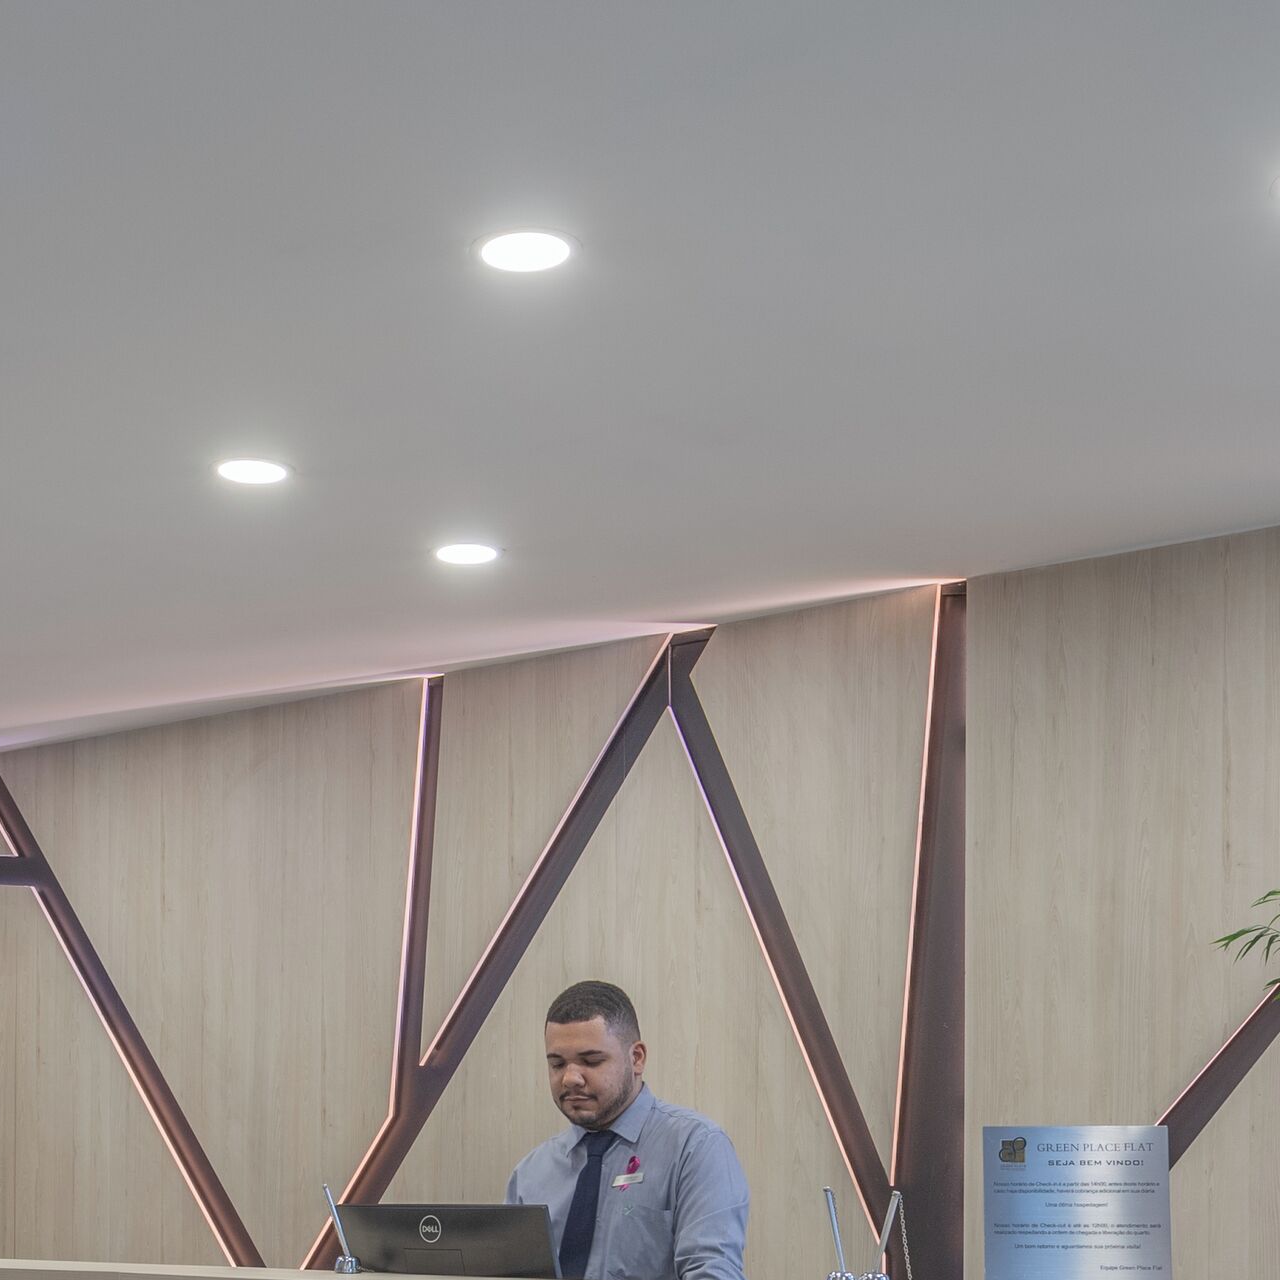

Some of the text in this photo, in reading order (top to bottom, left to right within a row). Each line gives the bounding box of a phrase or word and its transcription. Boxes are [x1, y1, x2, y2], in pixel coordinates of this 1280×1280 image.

[1037, 1142, 1154, 1152] GREEN PLACE FLAT
[422, 1225, 439, 1233] DELL
